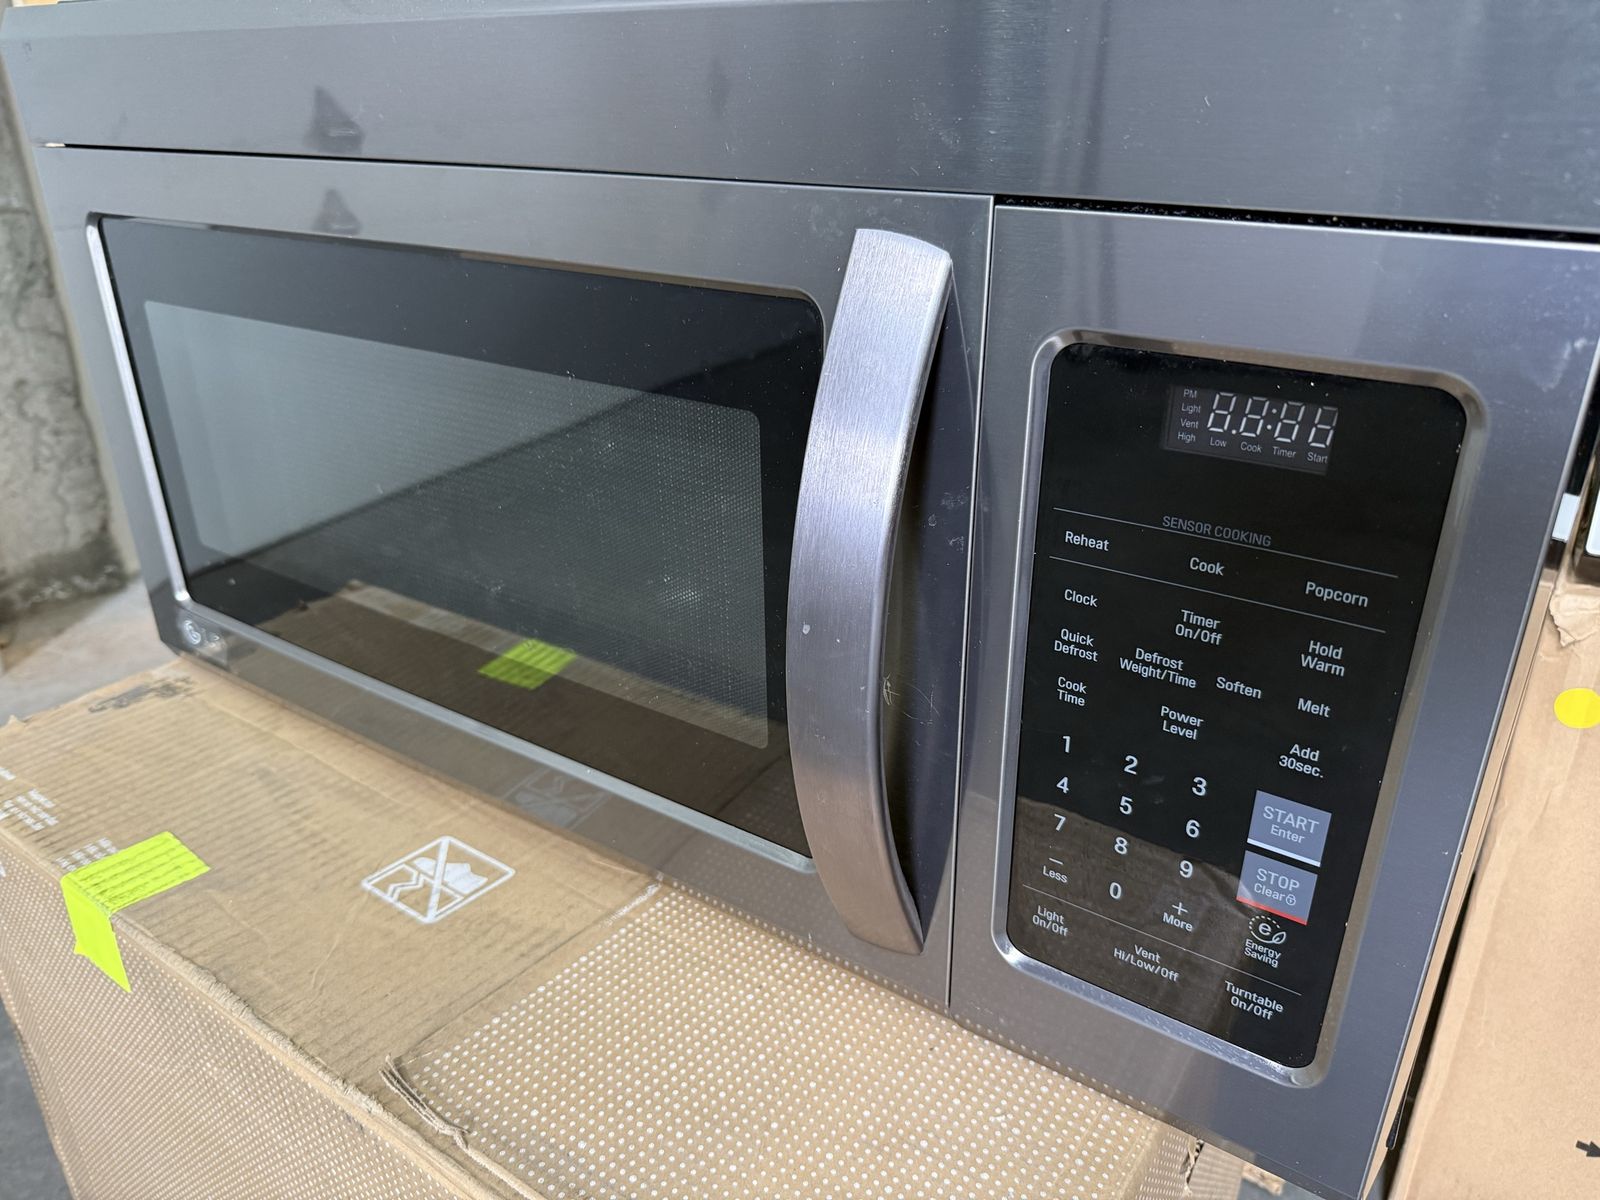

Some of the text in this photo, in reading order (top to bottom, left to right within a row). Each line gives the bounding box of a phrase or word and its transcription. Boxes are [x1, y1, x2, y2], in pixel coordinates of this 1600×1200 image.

[1182, 388, 1198, 400] PM
[1180, 404, 1202, 415] Light
[1179, 418, 1199, 430] Vent
[1176, 432, 1197, 443] High
[1209, 437, 1329, 464] Low Cook Timer Start
[1064, 530, 1109, 552] Reheat
[1162, 515, 1272, 548] SENSOR COOKING
[1189, 556, 1225, 577] Cook
[1063, 588, 1098, 608] Clock
[1305, 582, 1369, 607] Popcorn
[1180, 609, 1221, 630] Timer
[1059, 628, 1094, 648] Quick
[1174, 623, 1222, 646] On/Off
[1053, 640, 1099, 663] Defrost
[1134, 647, 1184, 672] Defrost
[1308, 640, 1343, 660] Hold
[1118, 657, 1197, 690] Weight/Time
[1300, 654, 1346, 678] Warm
[1057, 676, 1087, 695] Cook
[1215, 676, 1263, 700] Soften
[1056, 689, 1086, 707] Time
[1297, 698, 1331, 718] Melt
[1160, 705, 1204, 728] Power
[1162, 719, 1199, 741] Level
[1289, 743, 1321, 763] Add
[1062, 735, 1208, 798] 1 2 3
[1278, 755, 1325, 780] 30sec.
[1056, 776, 1201, 840] 4 5 6
[1263, 805, 1319, 834] START
[1269, 823, 1306, 845] Enter
[1053, 813, 1194, 880] 7 8 9
[1042, 865, 1069, 884] Less
[1255, 867, 1301, 893] STOP
[1108, 881, 1123, 901] 0
[1252, 881, 1288, 903] Clear
[1031, 914, 1069, 938] On/Off
[1036, 904, 1065, 926] Light
[1162, 911, 1194, 934] More
[1133, 943, 1161, 965] Vent
[1244, 948, 1279, 968] Saving
[1245, 938, 1282, 960] Energy
[1113, 946, 1180, 983] Hi/Low/Off
[1224, 979, 1285, 1014] Turntable
[1229, 994, 1274, 1021] On/Off
